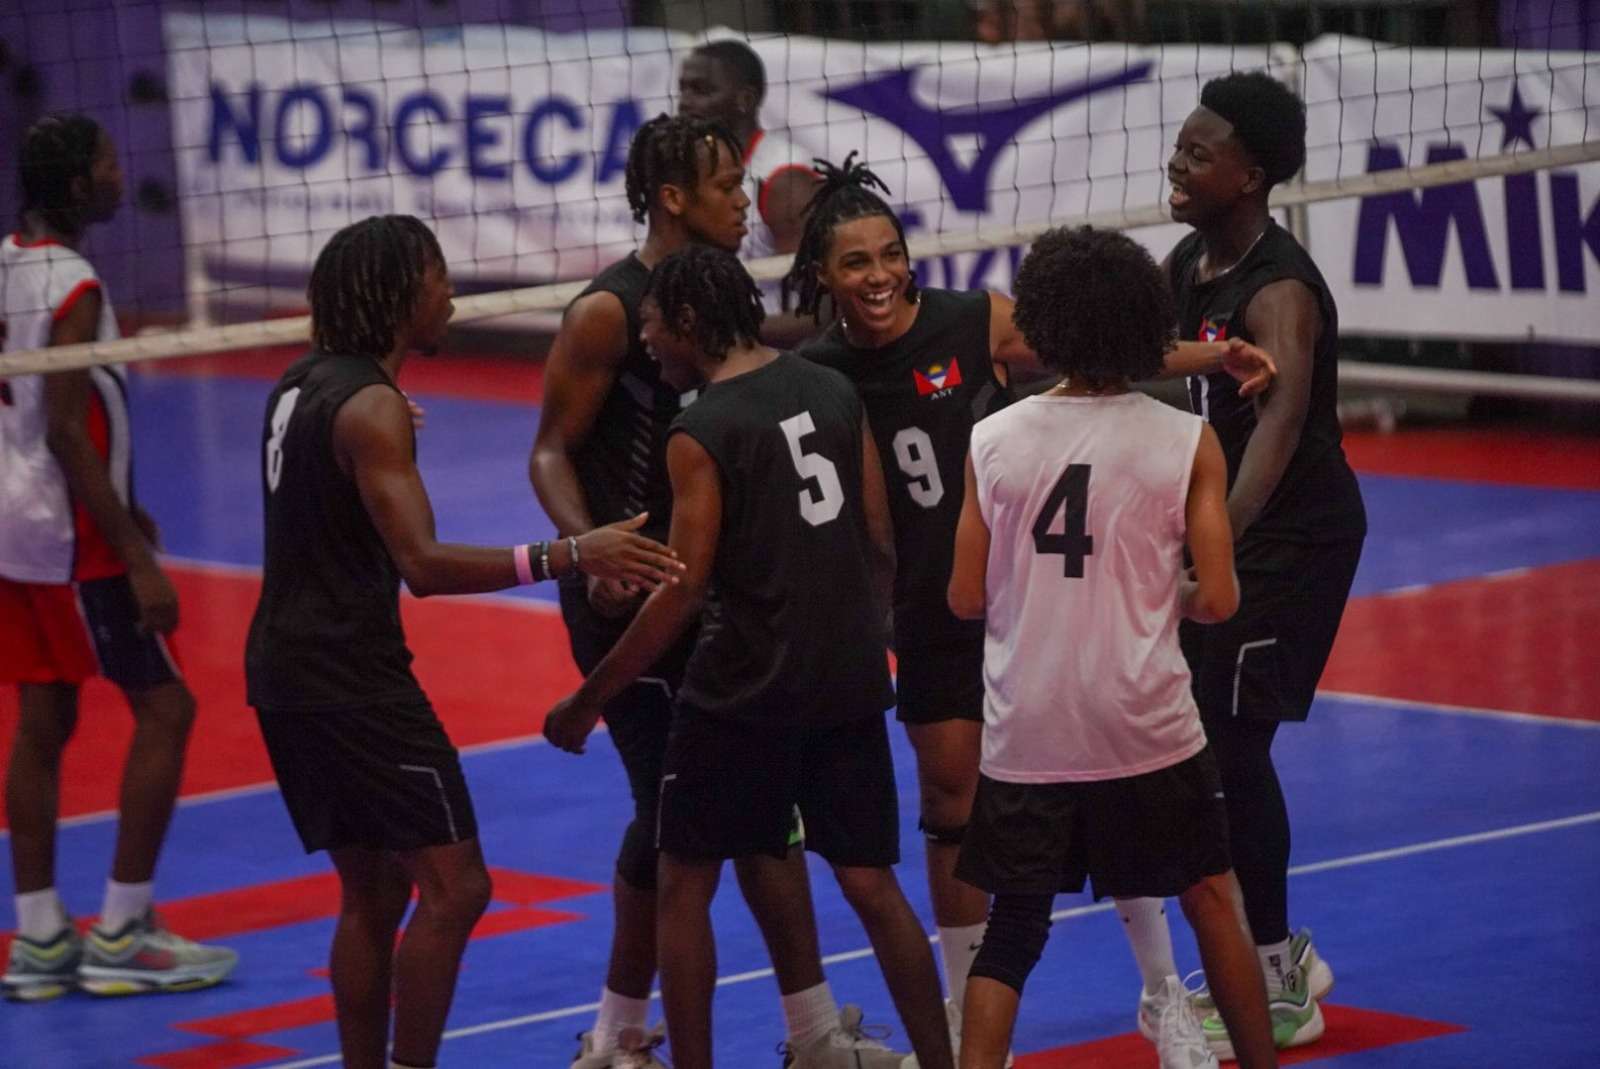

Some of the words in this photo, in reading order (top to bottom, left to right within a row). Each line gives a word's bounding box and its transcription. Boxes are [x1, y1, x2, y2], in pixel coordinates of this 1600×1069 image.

[207, 82, 645, 184] NORCECA
[266, 386, 300, 494] 8
[779, 411, 844, 527] 5
[893, 426, 944, 509] 9
[1032, 463, 1093, 578] 4
